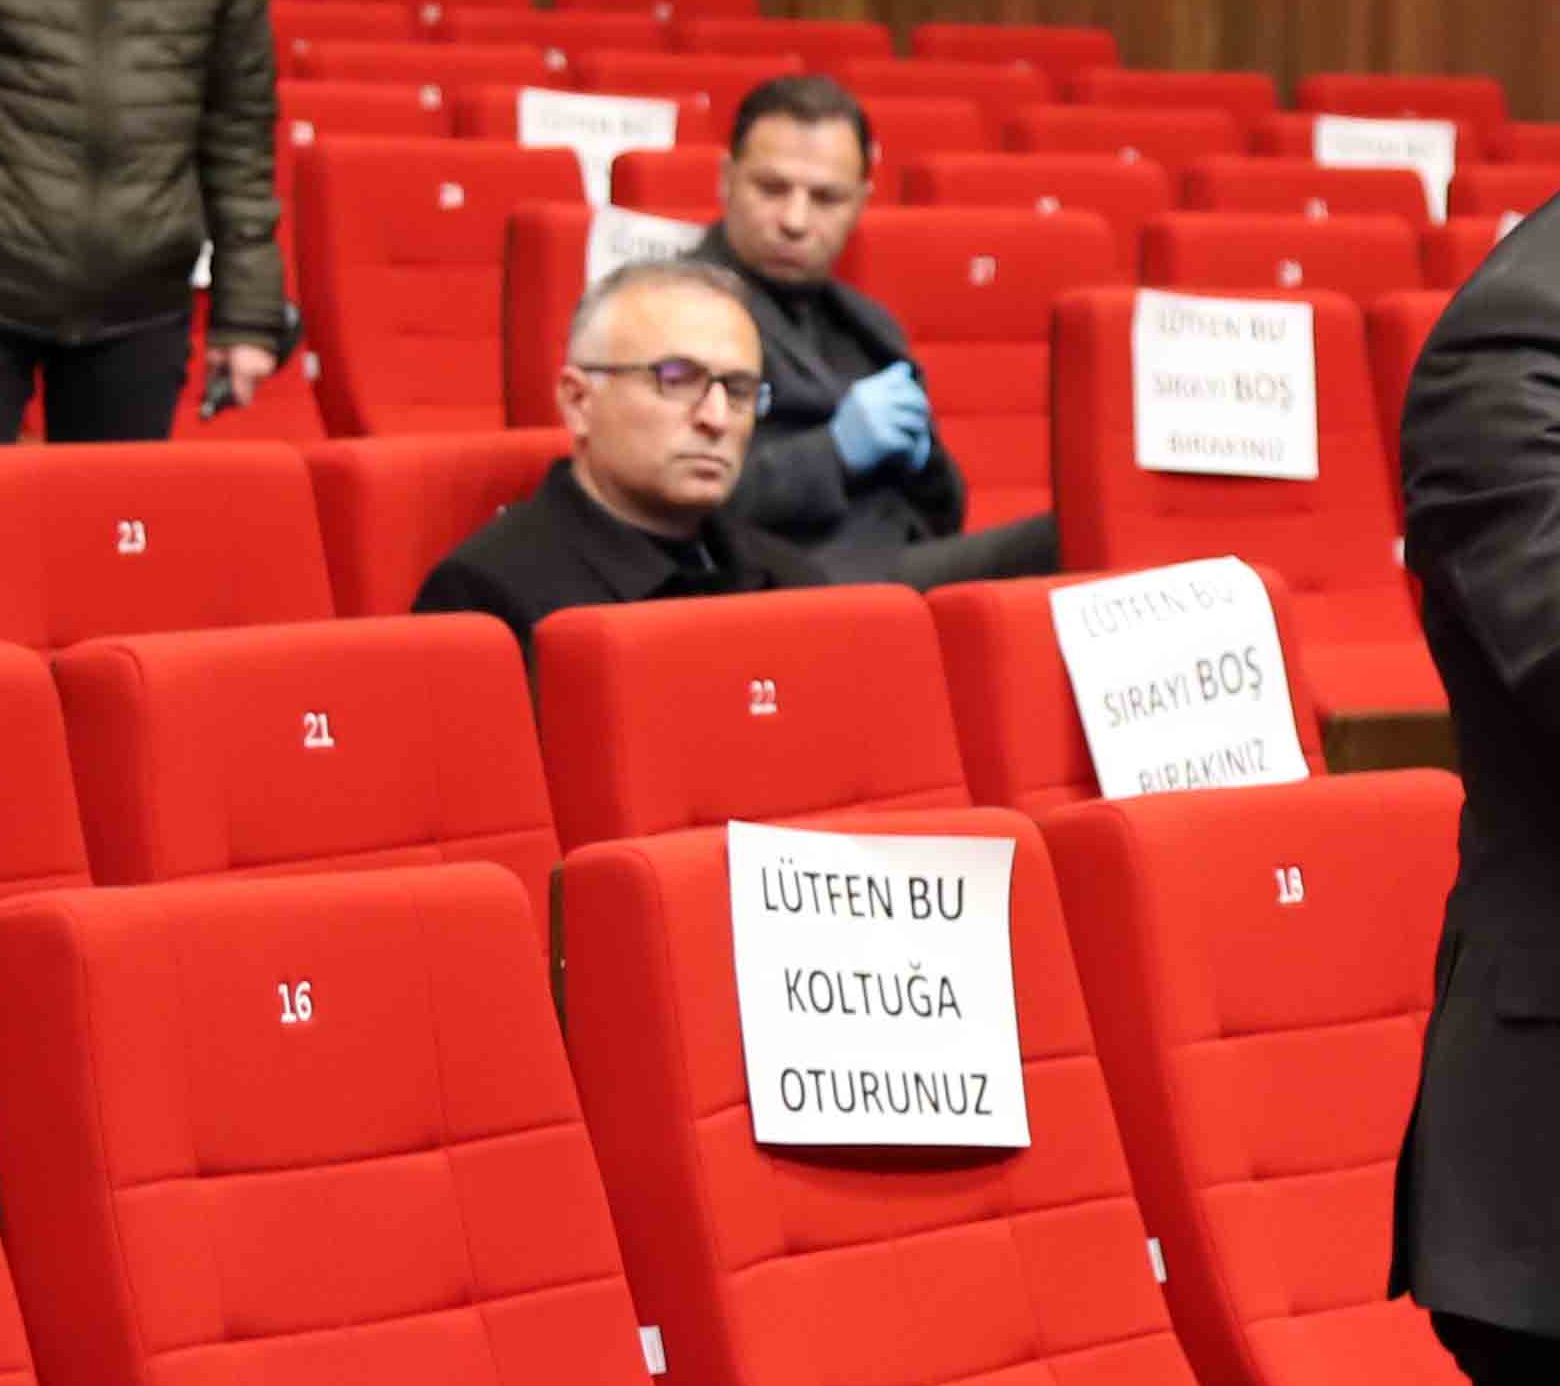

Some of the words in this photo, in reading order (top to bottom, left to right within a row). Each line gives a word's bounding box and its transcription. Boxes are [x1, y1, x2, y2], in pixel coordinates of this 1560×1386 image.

[117, 520, 148, 553] 23
[1103, 672, 1192, 729] SIRAYI
[1195, 645, 1263, 702] BOŞ
[303, 712, 335, 749] 21
[761, 856, 894, 920] LÜTFEN
[908, 875, 965, 921] BU
[278, 979, 313, 1024] 16
[784, 961, 962, 1019] KOLTUĞA
[779, 1067, 993, 1117] OTURUNUZ
